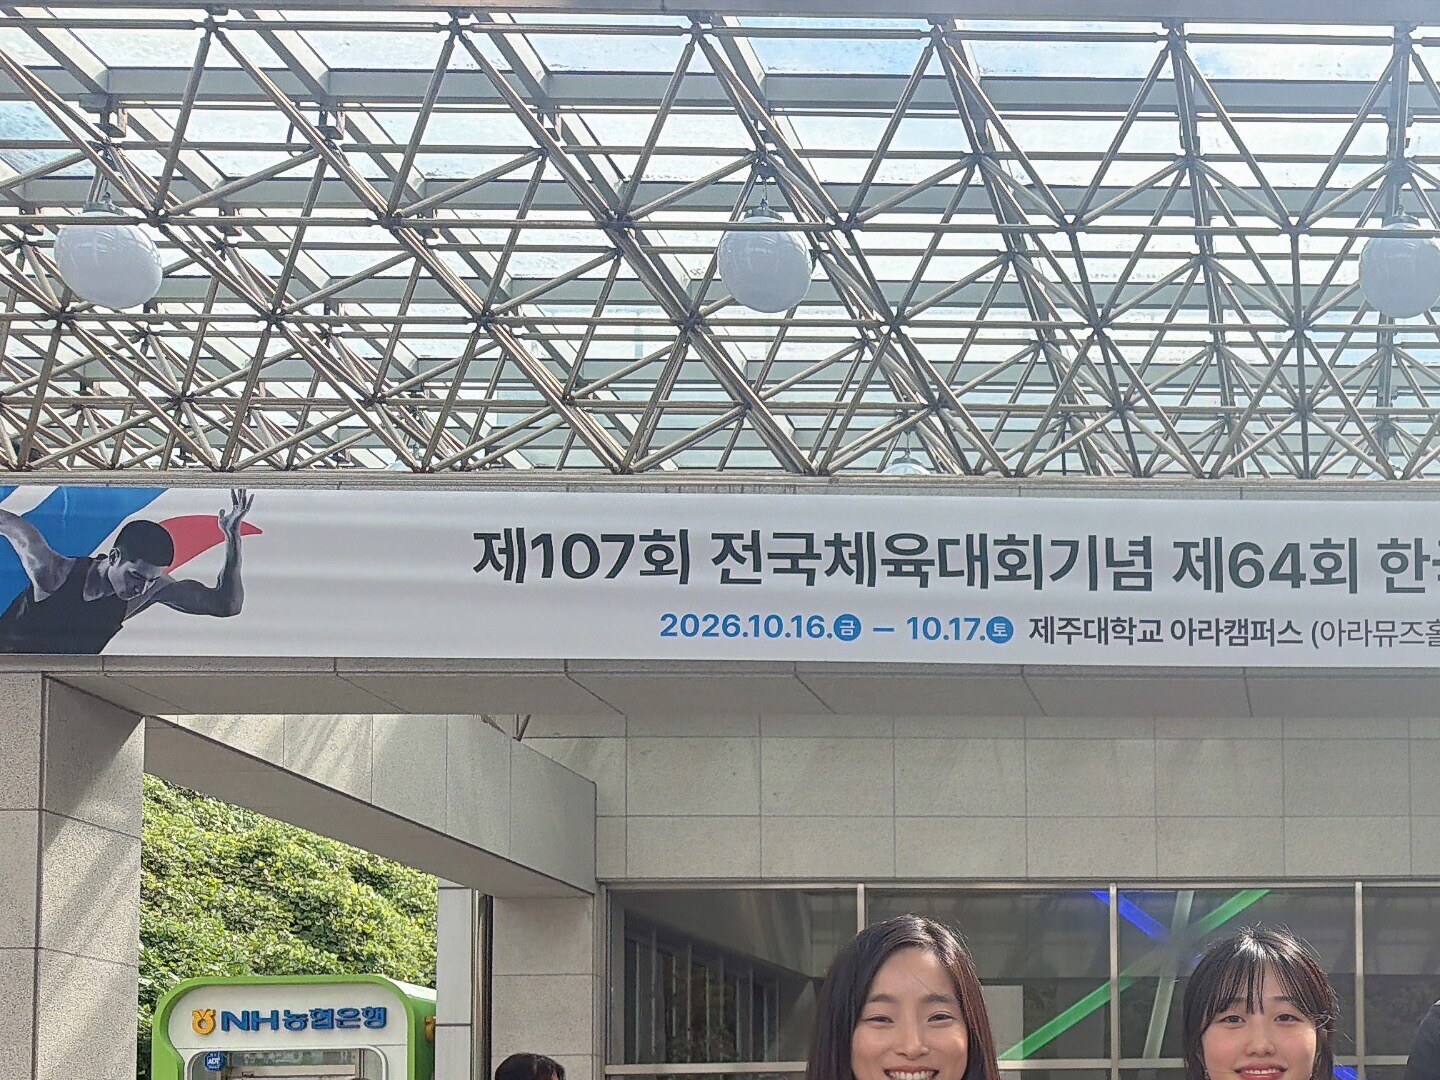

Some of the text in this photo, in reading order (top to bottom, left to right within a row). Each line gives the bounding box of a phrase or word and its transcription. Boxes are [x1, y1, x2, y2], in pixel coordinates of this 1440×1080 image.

[473, 527, 690, 584] 제107회
[711, 529, 1152, 591] 전국체육대회기념
[1172, 536, 1358, 594] 제64회
[1029, 616, 1163, 646] 제주대학교
[1170, 617, 1304, 647] 아라캠퍼스
